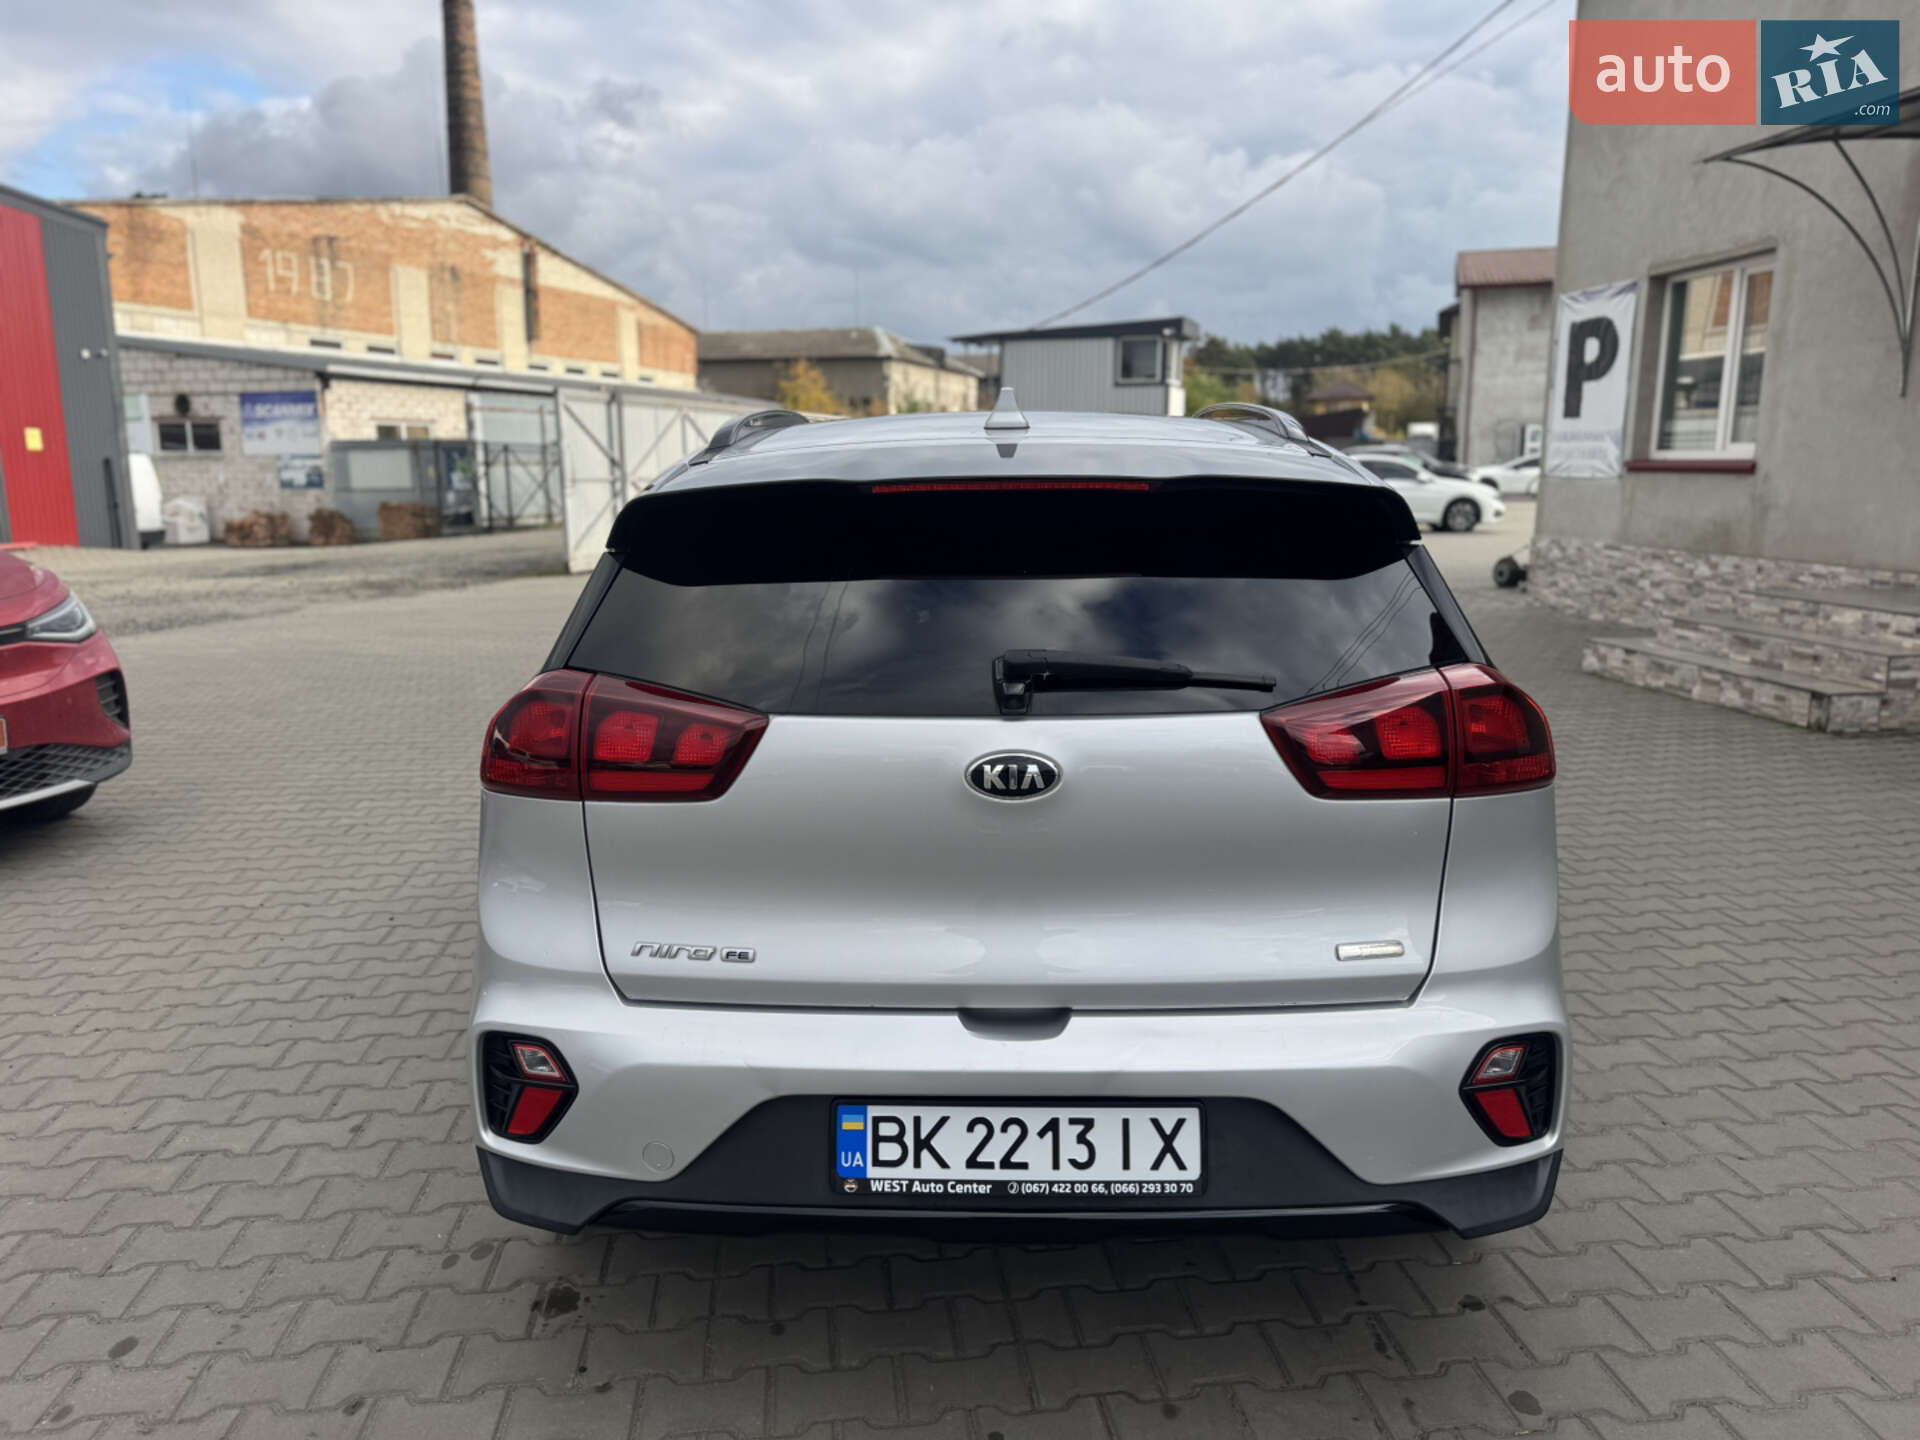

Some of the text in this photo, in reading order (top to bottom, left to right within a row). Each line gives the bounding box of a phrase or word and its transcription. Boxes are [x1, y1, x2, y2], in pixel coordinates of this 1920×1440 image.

[1563, 316, 1619, 419] P
[982, 763, 1045, 790] KIA
[631, 941, 717, 961] niro
[870, 1115, 951, 1169] BK
[965, 1116, 1096, 1171] 2213
[840, 1152, 865, 1167] UA
[870, 1179, 1193, 1195] WEST Auto Center (067) 422 00 66, (066) 293 30 70
